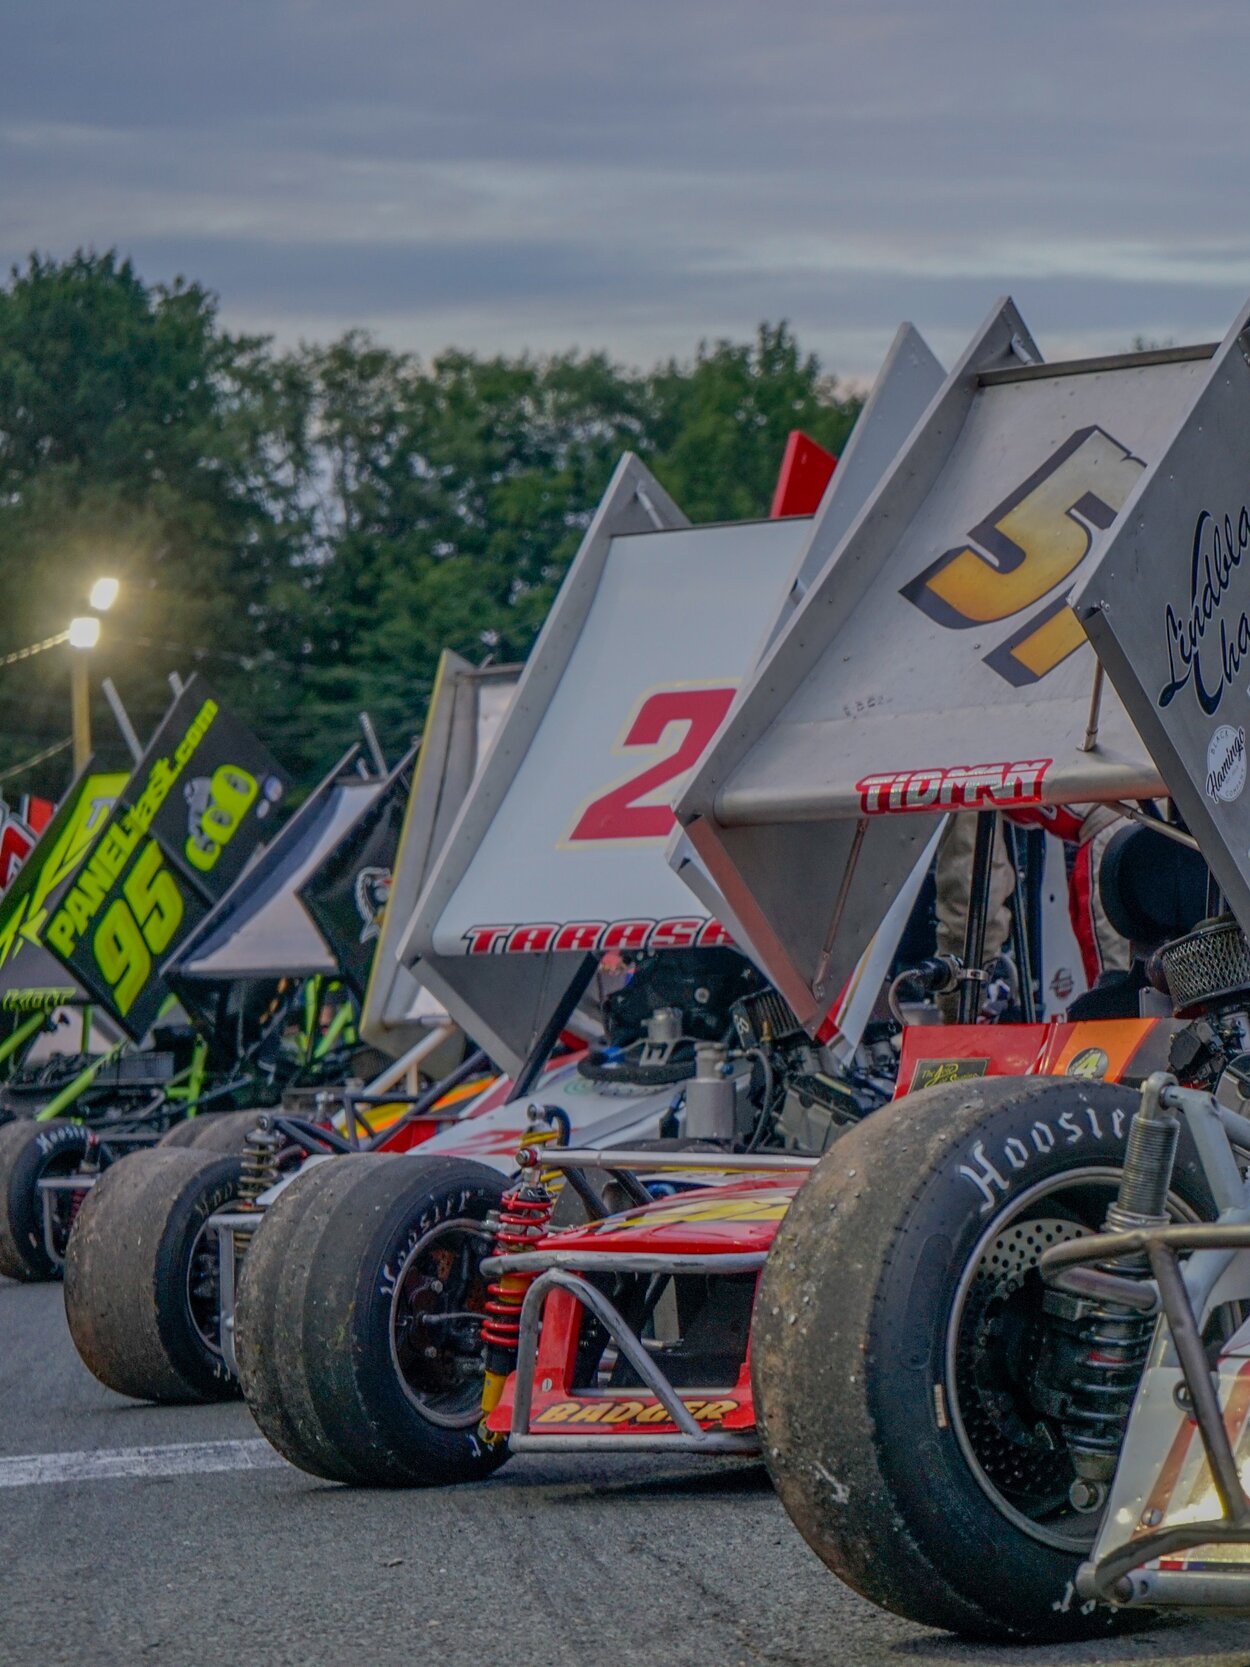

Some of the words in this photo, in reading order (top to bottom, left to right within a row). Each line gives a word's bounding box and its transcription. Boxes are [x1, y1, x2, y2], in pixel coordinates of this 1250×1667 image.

[897, 424, 1148, 688] 5
[94, 838, 184, 1017] 95
[956, 1093, 1126, 1213] Hoosie
